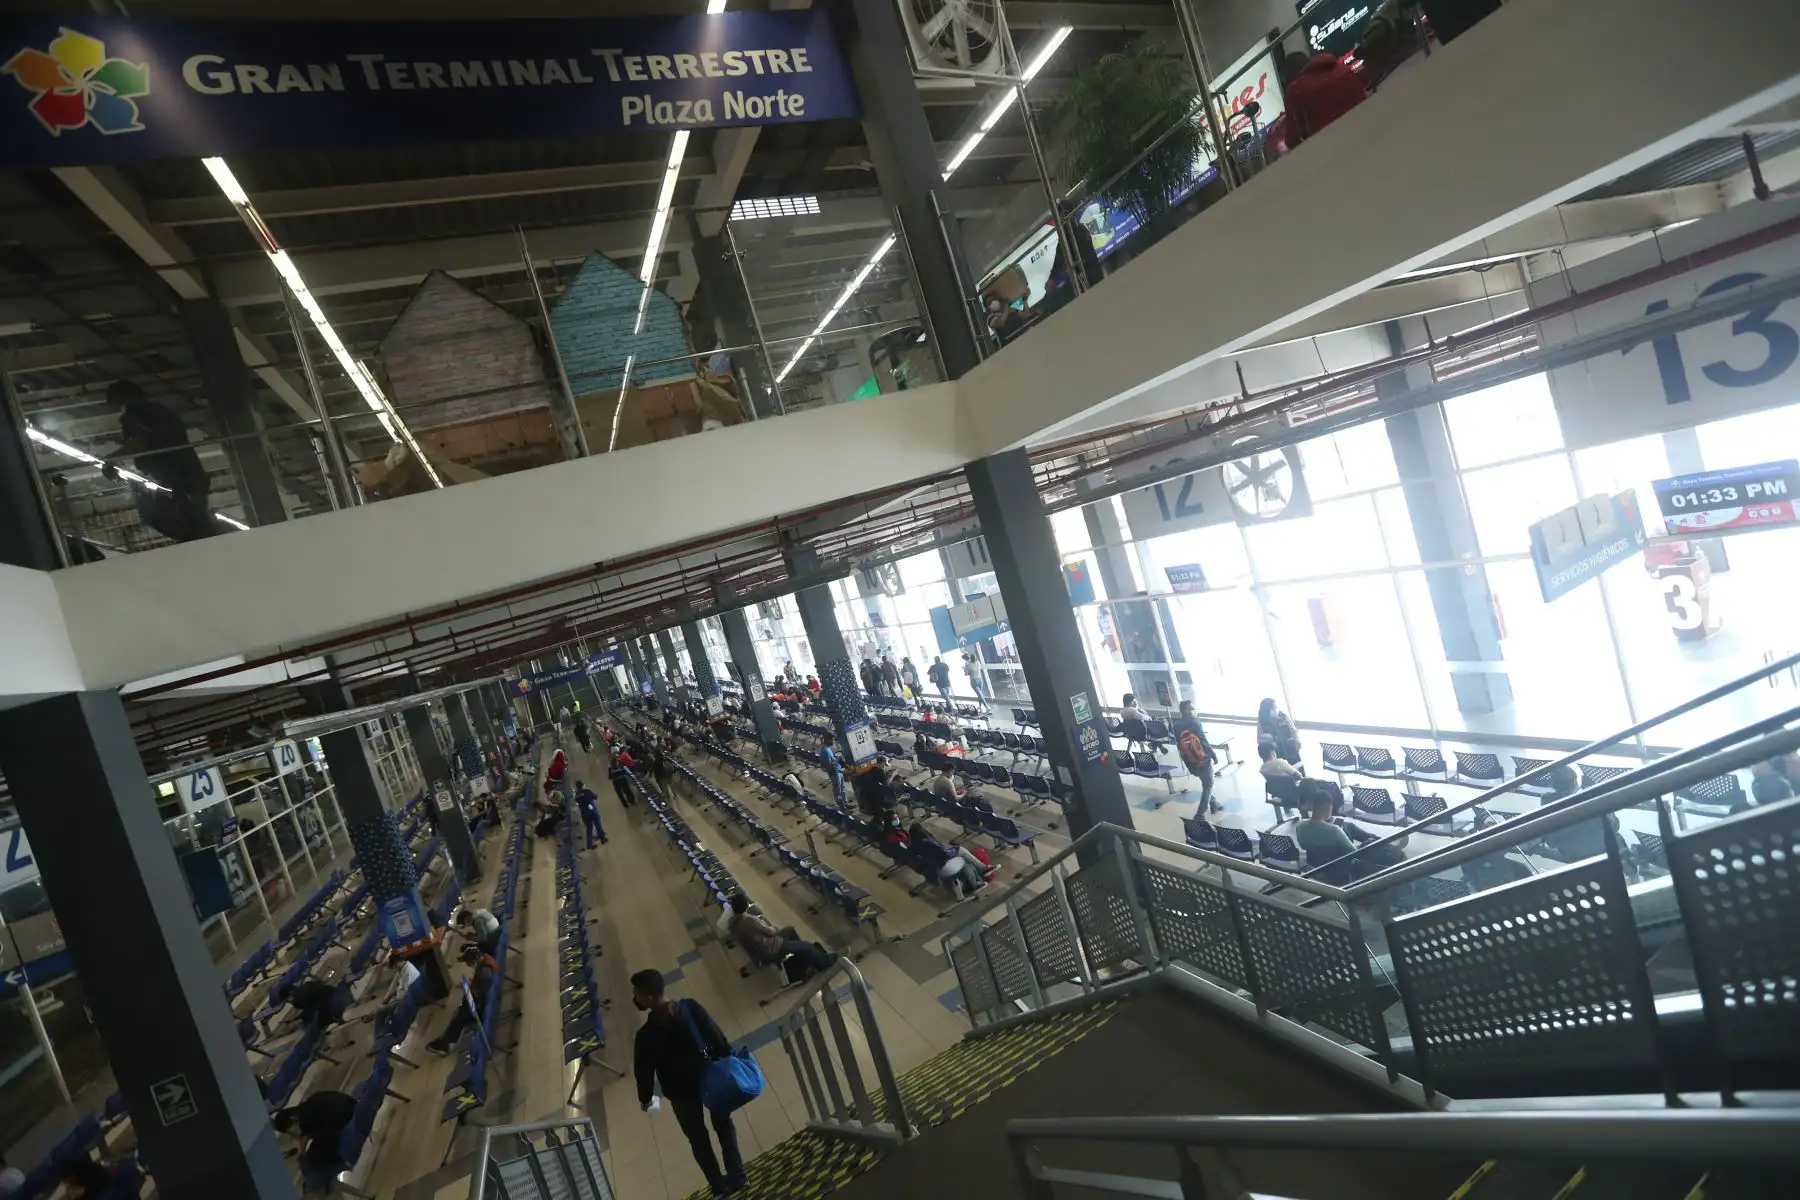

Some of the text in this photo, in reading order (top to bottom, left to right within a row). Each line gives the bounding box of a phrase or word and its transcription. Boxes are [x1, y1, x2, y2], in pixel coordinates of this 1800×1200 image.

[182, 48, 812, 94] GRAN TERMINAL TERRESTRE
[621, 89, 805, 126] Plaza Norte
[1621, 273, 1799, 405] 13
[1144, 457, 1204, 521] 12
[1671, 480, 1787, 507] 01:33 PM
[1550, 559, 1590, 588] SERVICIOS
